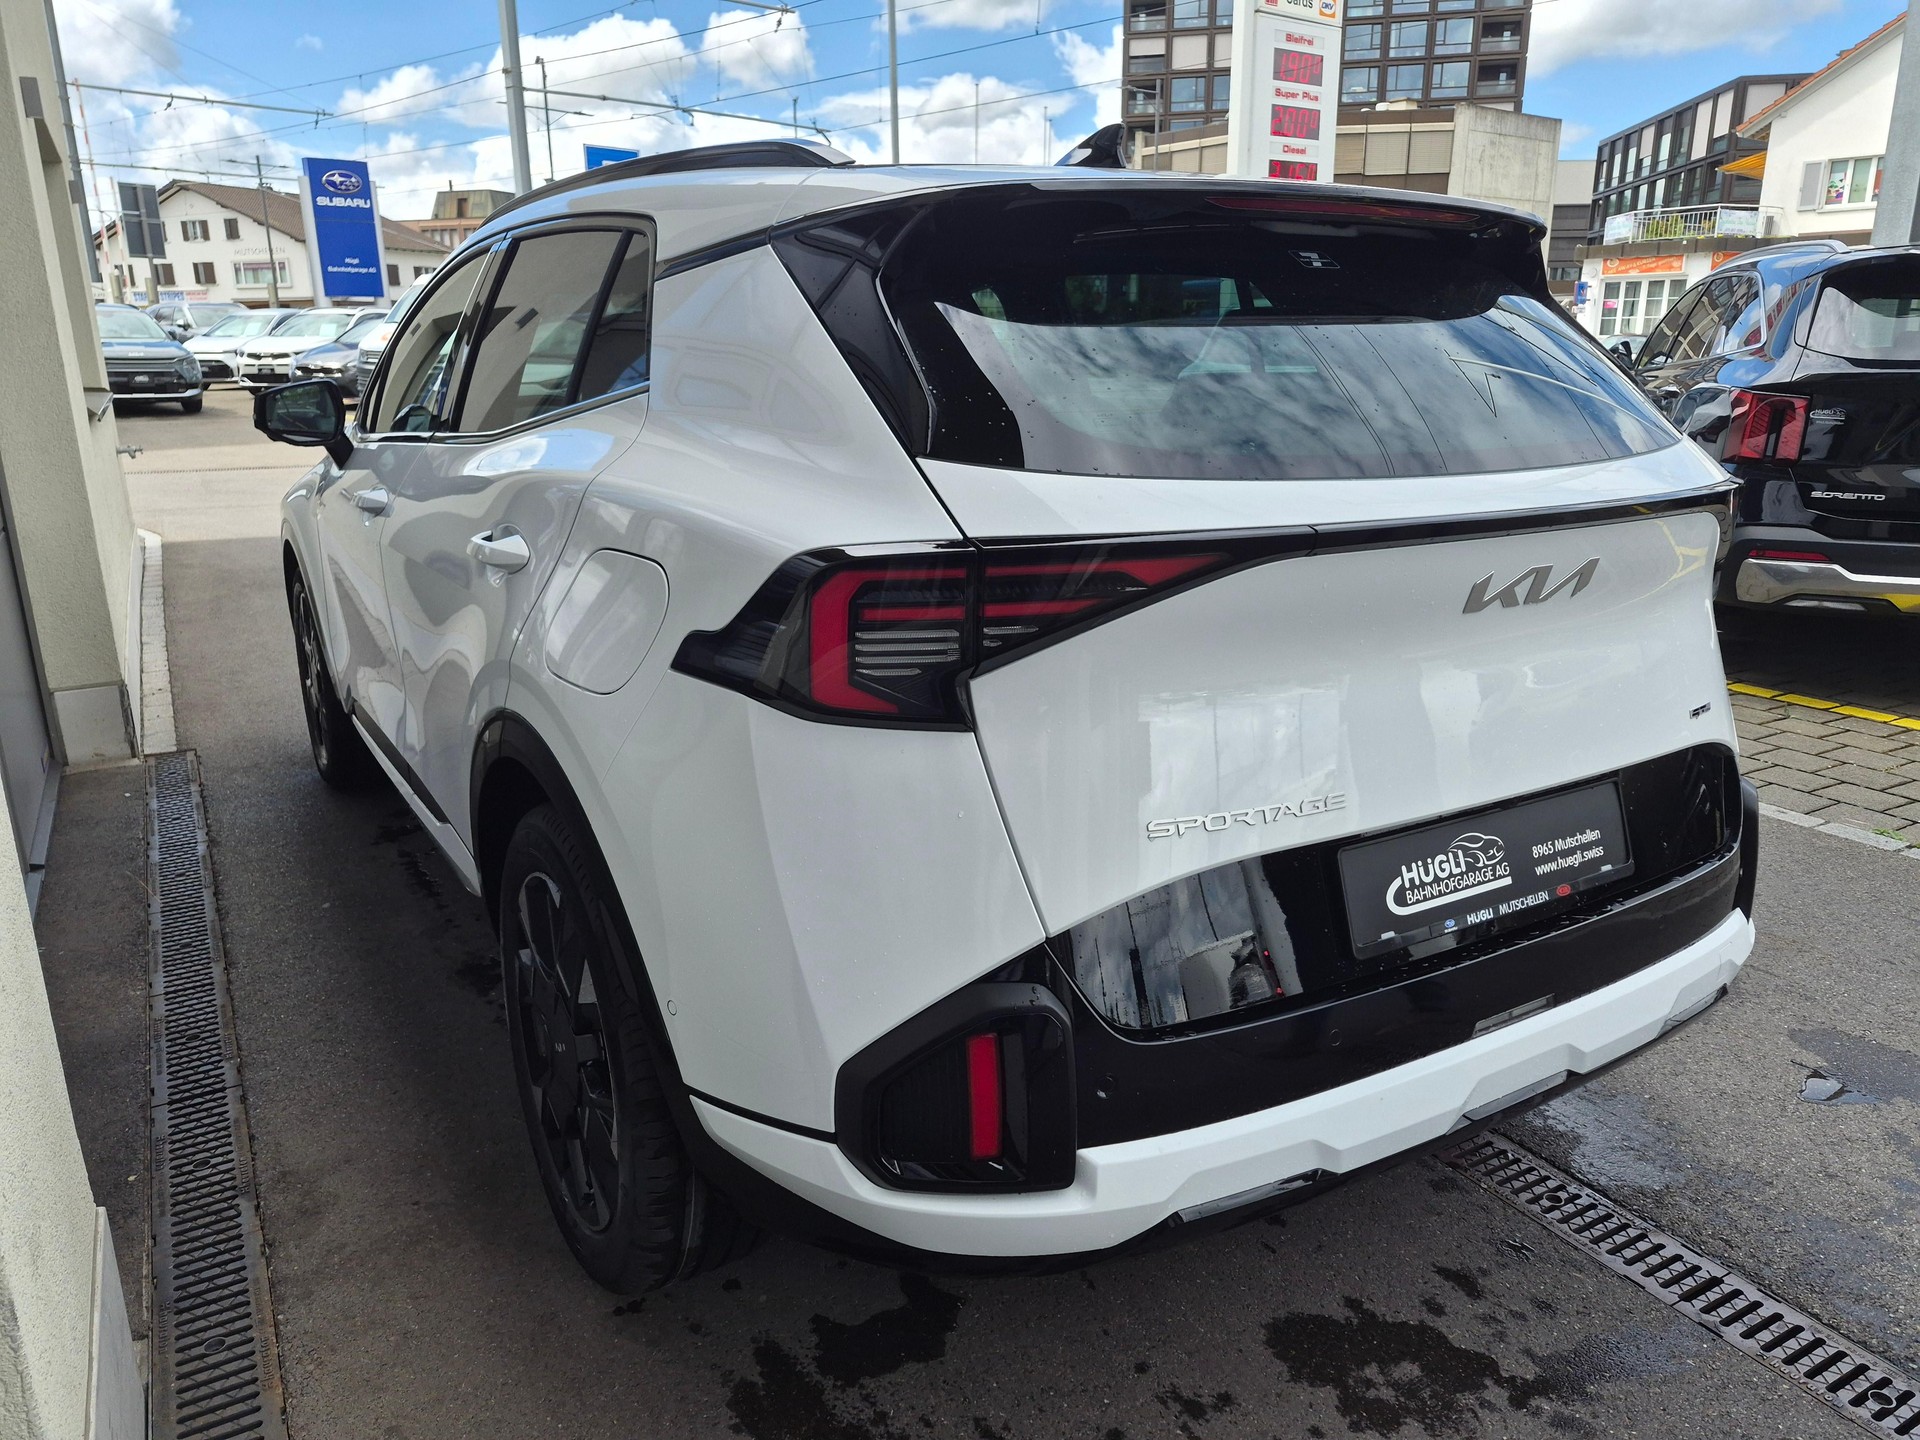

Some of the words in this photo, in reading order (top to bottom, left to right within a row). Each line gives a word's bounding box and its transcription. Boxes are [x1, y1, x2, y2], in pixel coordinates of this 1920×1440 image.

[1286, 33, 1314, 46] Bleifrei
[1275, 88, 1299, 99] Super
[1302, 91, 1319, 102] Plus
[1283, 144, 1307, 155] Diesel
[316, 196, 371, 208] SUBARU
[1810, 491, 1886, 501] SORENTO
[1462, 556, 1600, 614] KIA
[1147, 792, 1346, 840] SPORTAGE
[1532, 841, 1554, 858] 8965
[1555, 829, 1601, 852] Mutschellen
[1401, 849, 1467, 888] HÜGLI
[1535, 846, 1604, 876] www.huegli.swiss
[1406, 867, 1494, 904] BAHNHOFGARAGE
[1495, 862, 1510, 878] AG
[1499, 891, 1549, 915] MUTSCHELLEN
